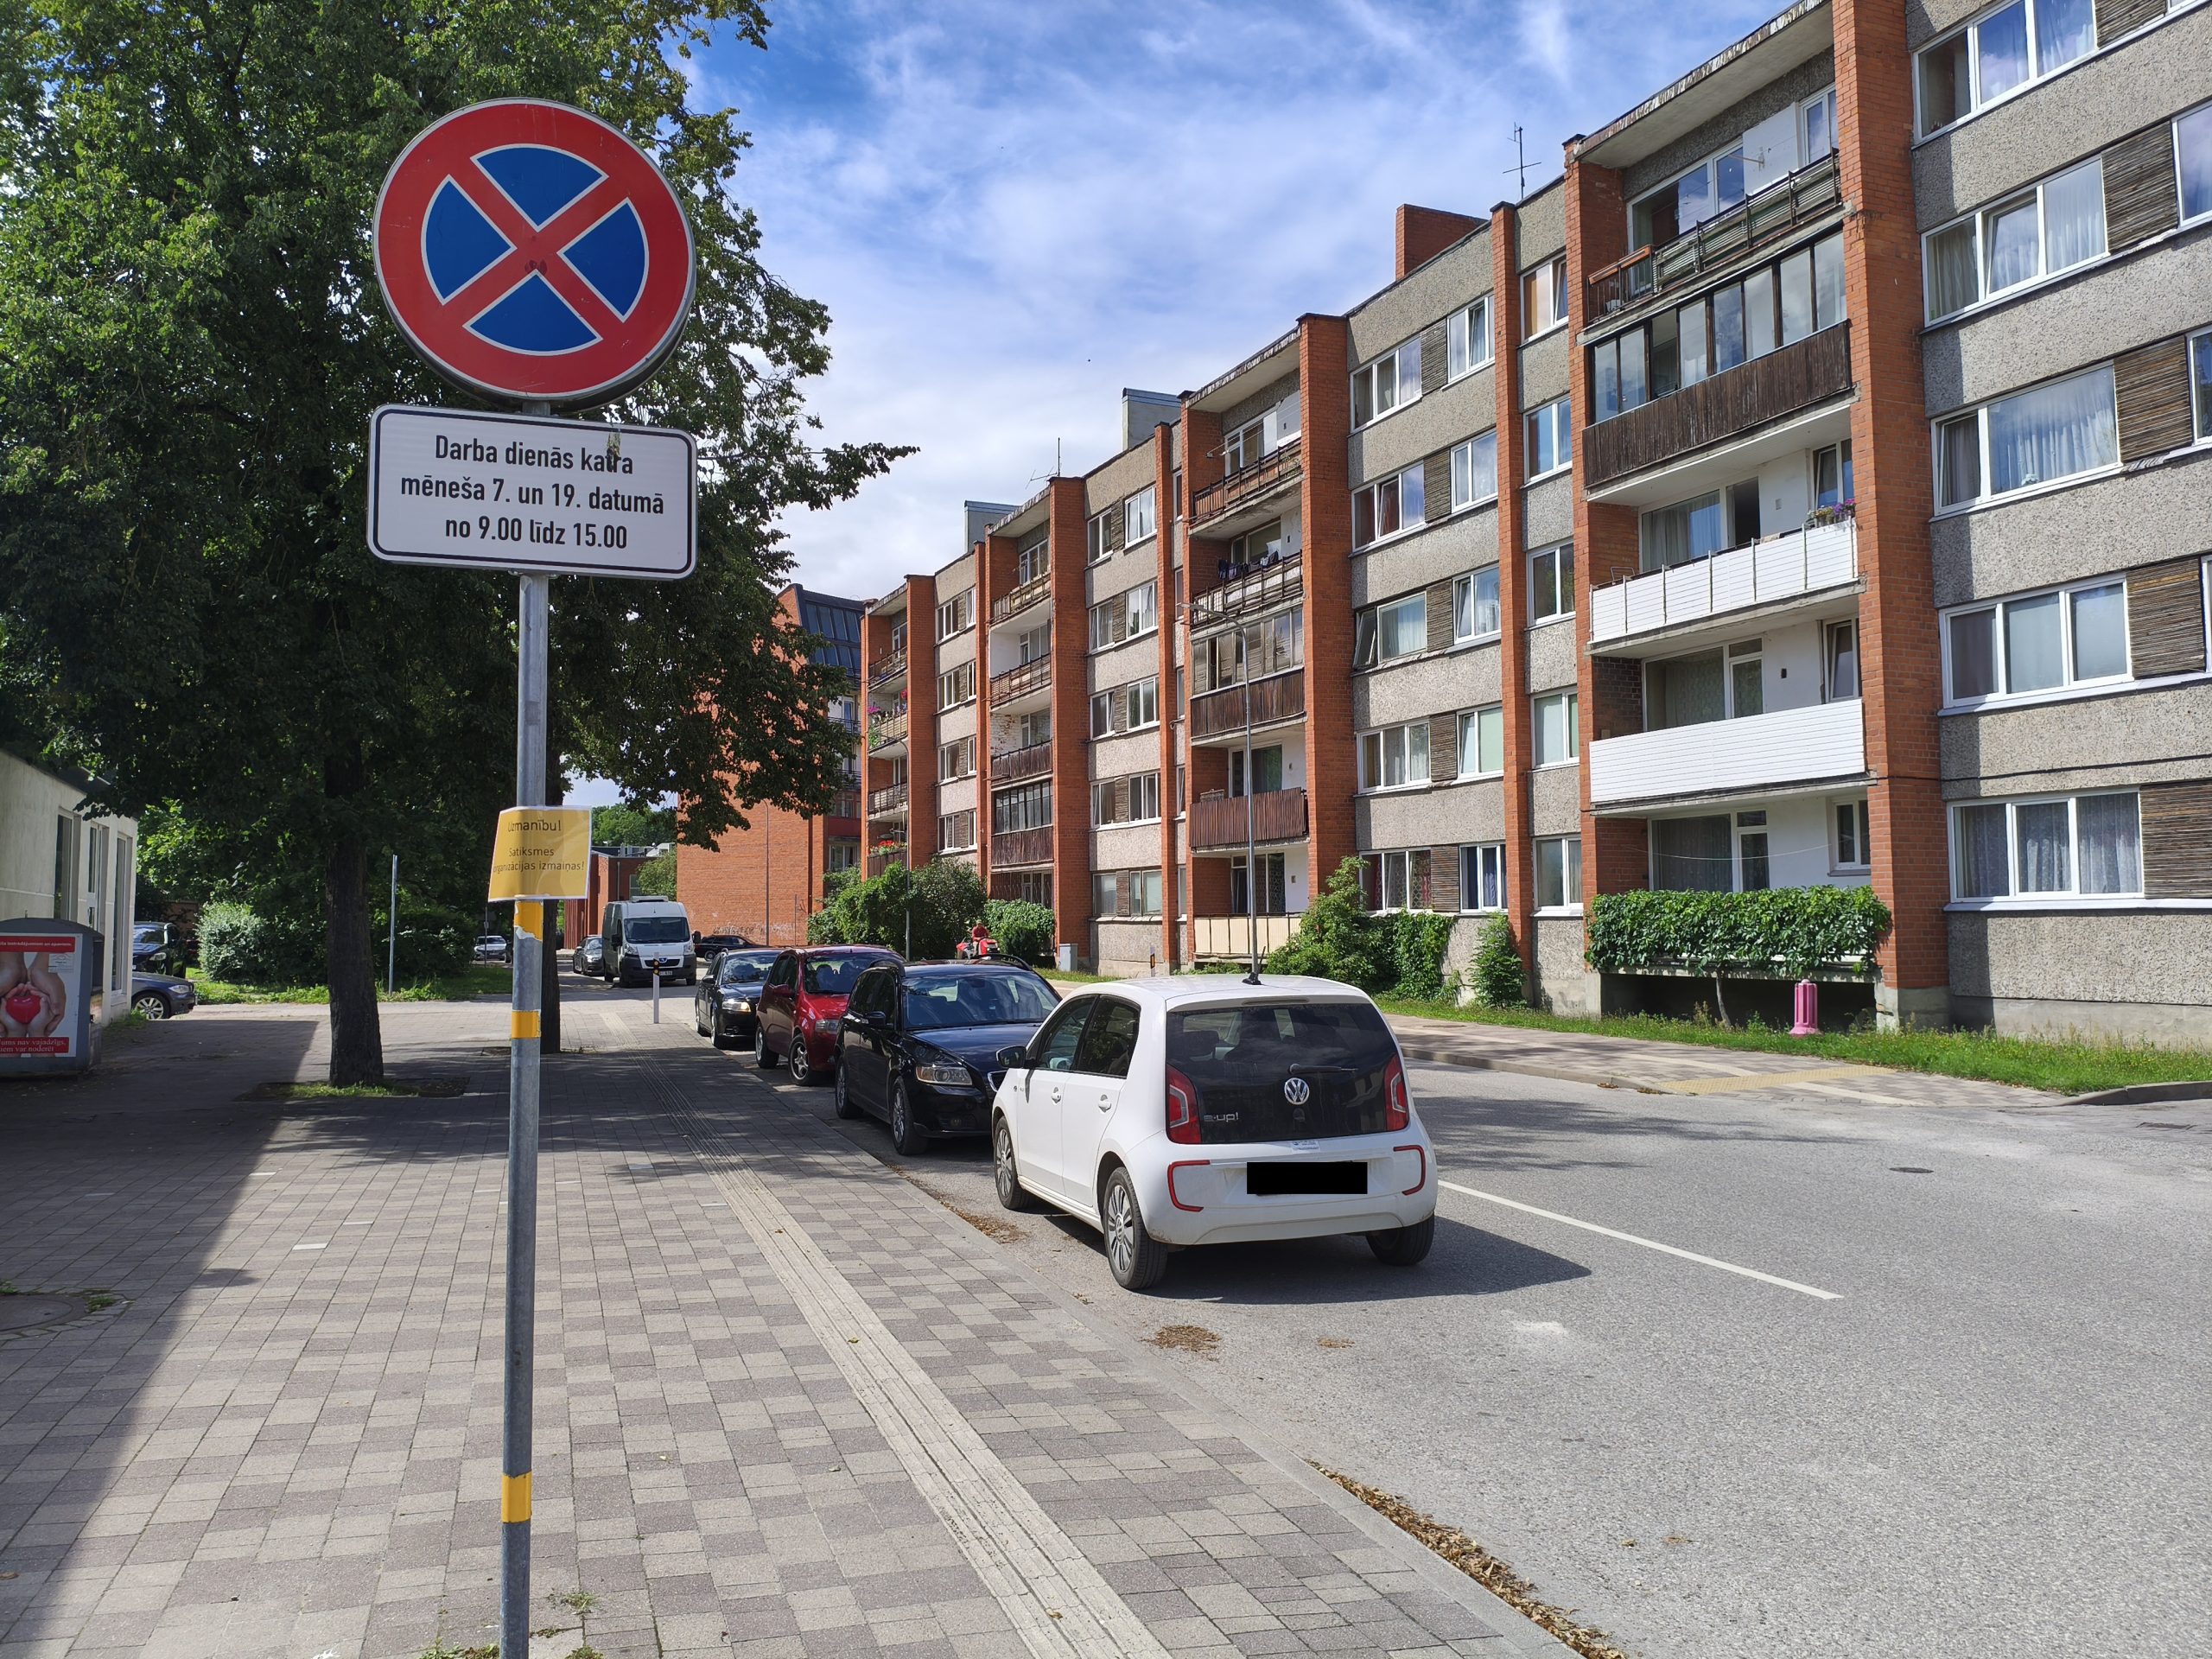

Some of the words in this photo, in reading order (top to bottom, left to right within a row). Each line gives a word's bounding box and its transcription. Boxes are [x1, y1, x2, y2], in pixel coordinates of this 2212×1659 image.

[435, 435, 498, 463] Darba
[505, 442, 574, 469] dienās
[581, 448, 632, 474] katra
[401, 475, 485, 501] mēneša
[493, 479, 511, 503] 7.
[518, 486, 543, 505] un
[551, 483, 581, 508] 19.
[588, 486, 664, 514] datumā
[445, 518, 470, 539] no
[479, 516, 522, 542] 9.00
[531, 519, 565, 545] līdz
[573, 523, 627, 549] 15.00
[508, 819, 562, 832] Uzmanību!
[509, 847, 554, 857] Satiksmes
[539, 861, 585, 873] izmaiņas!
